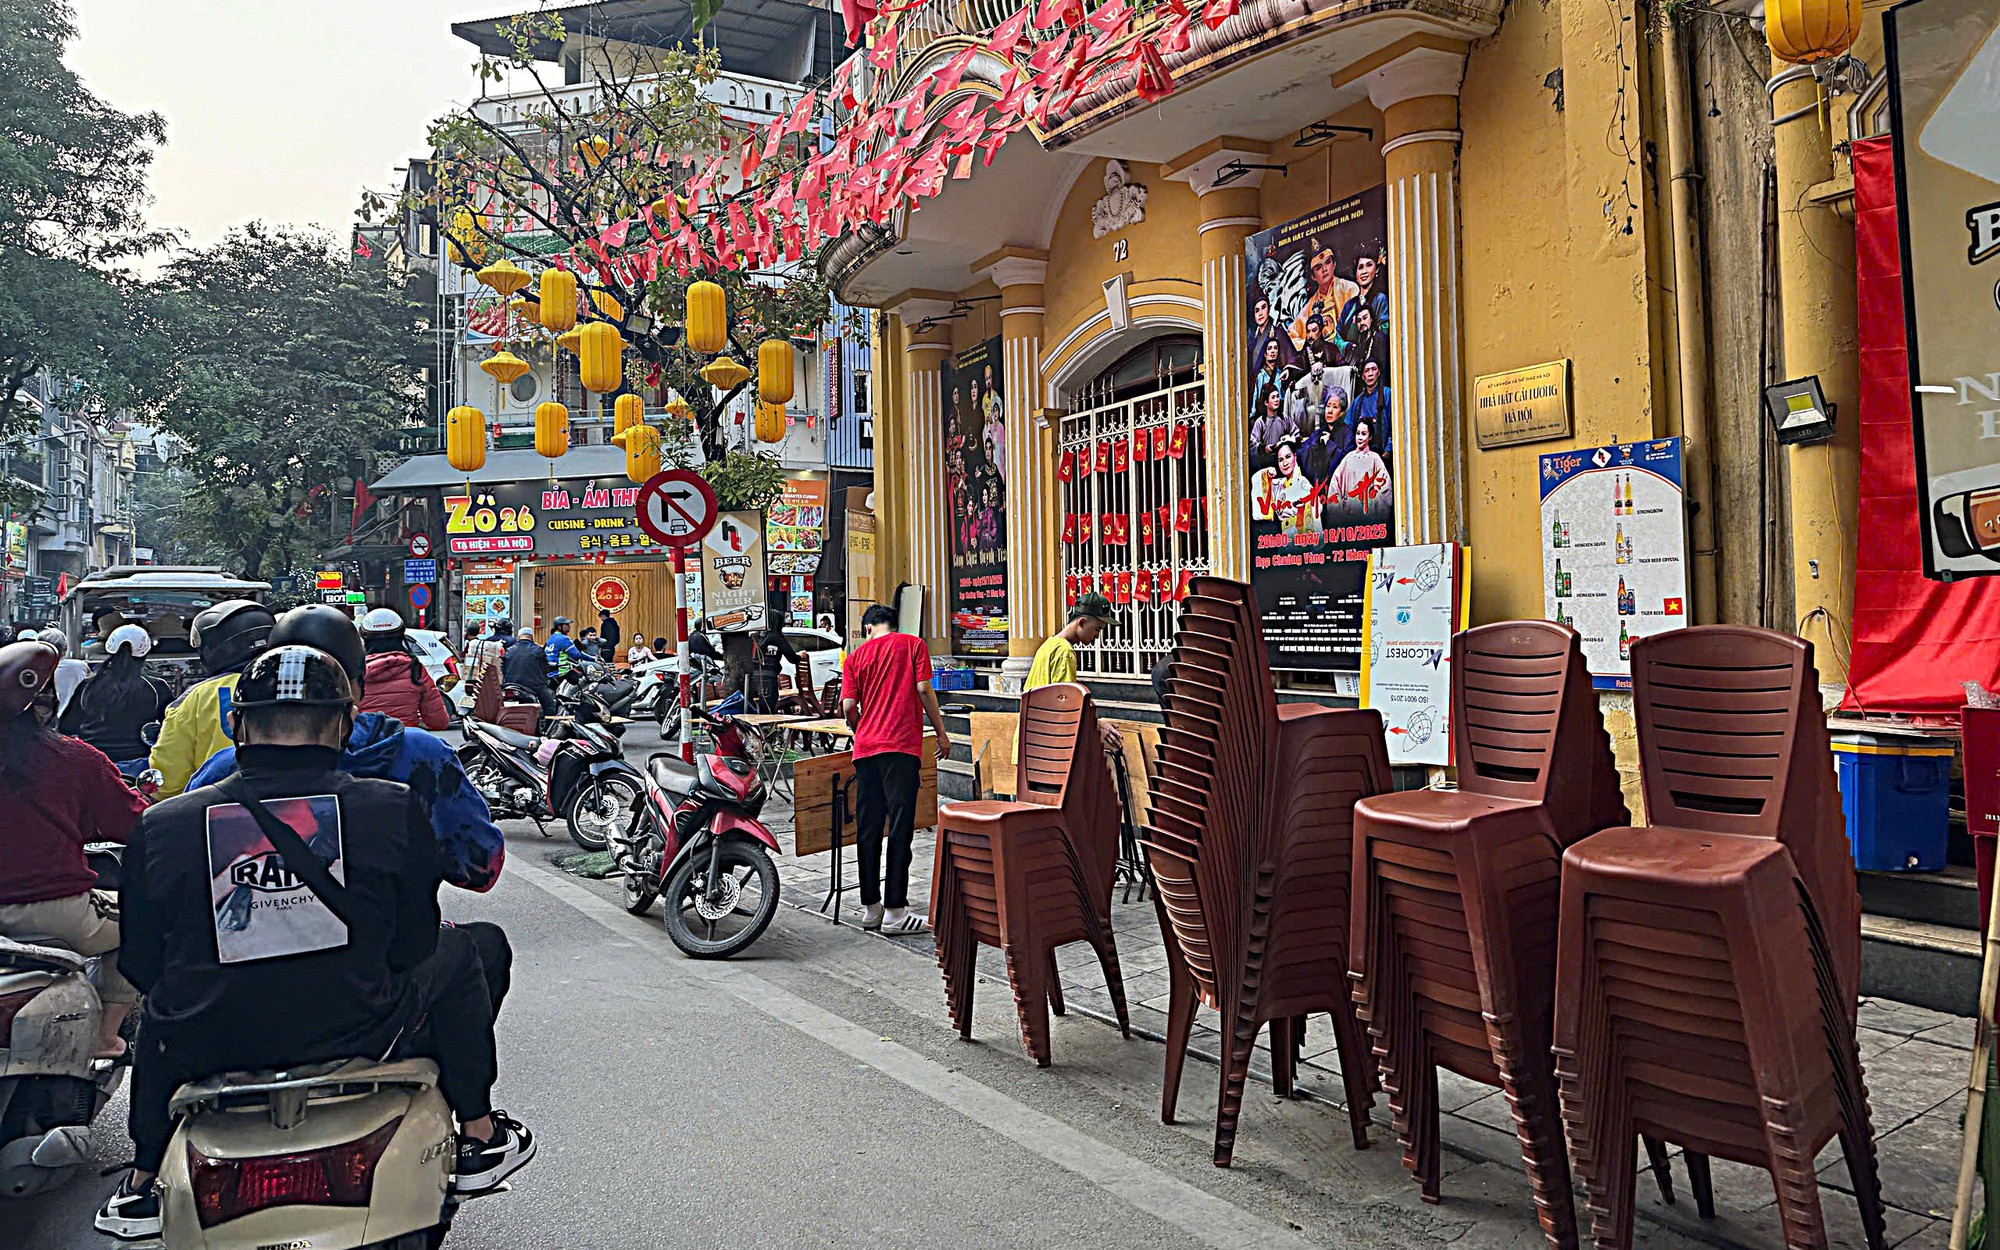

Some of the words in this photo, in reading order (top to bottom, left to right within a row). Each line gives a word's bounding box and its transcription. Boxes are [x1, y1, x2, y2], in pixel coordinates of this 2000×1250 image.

[1113, 239, 1128, 262] 72
[1480, 396, 1497, 409] NHÀ
[1498, 390, 1514, 405] HÁT
[1514, 387, 1528, 402] CẢI
[1529, 384, 1558, 400] LƯƠNG
[1504, 409, 1517, 424] HÀ
[1517, 406, 1533, 424] NỘI
[1553, 454, 1582, 473] Tiger
[581, 480, 610, 509] ẨM
[500, 504, 535, 532] 26
[548, 519, 586, 530] CUISINE
[594, 517, 625, 529] DRINK
[456, 541, 468, 550] TẠ
[469, 539, 490, 550] HIỆN
[497, 538, 511, 549] HÀ
[511, 538, 528, 549] NỘI
[580, 534, 602, 549] 음식
[609, 534, 631, 547] 음료
[1294, 528, 1320, 548] ngày
[1322, 523, 1387, 544] 18/10/2025
[714, 555, 752, 568] BEER
[1303, 550, 1325, 565] Vàng
[1332, 550, 1344, 562] 72
[711, 589, 758, 599] NIGHT
[715, 597, 752, 606] BEER
[1385, 649, 1444, 671] ALCOREST
[250, 894, 316, 910] GIVENCHY
